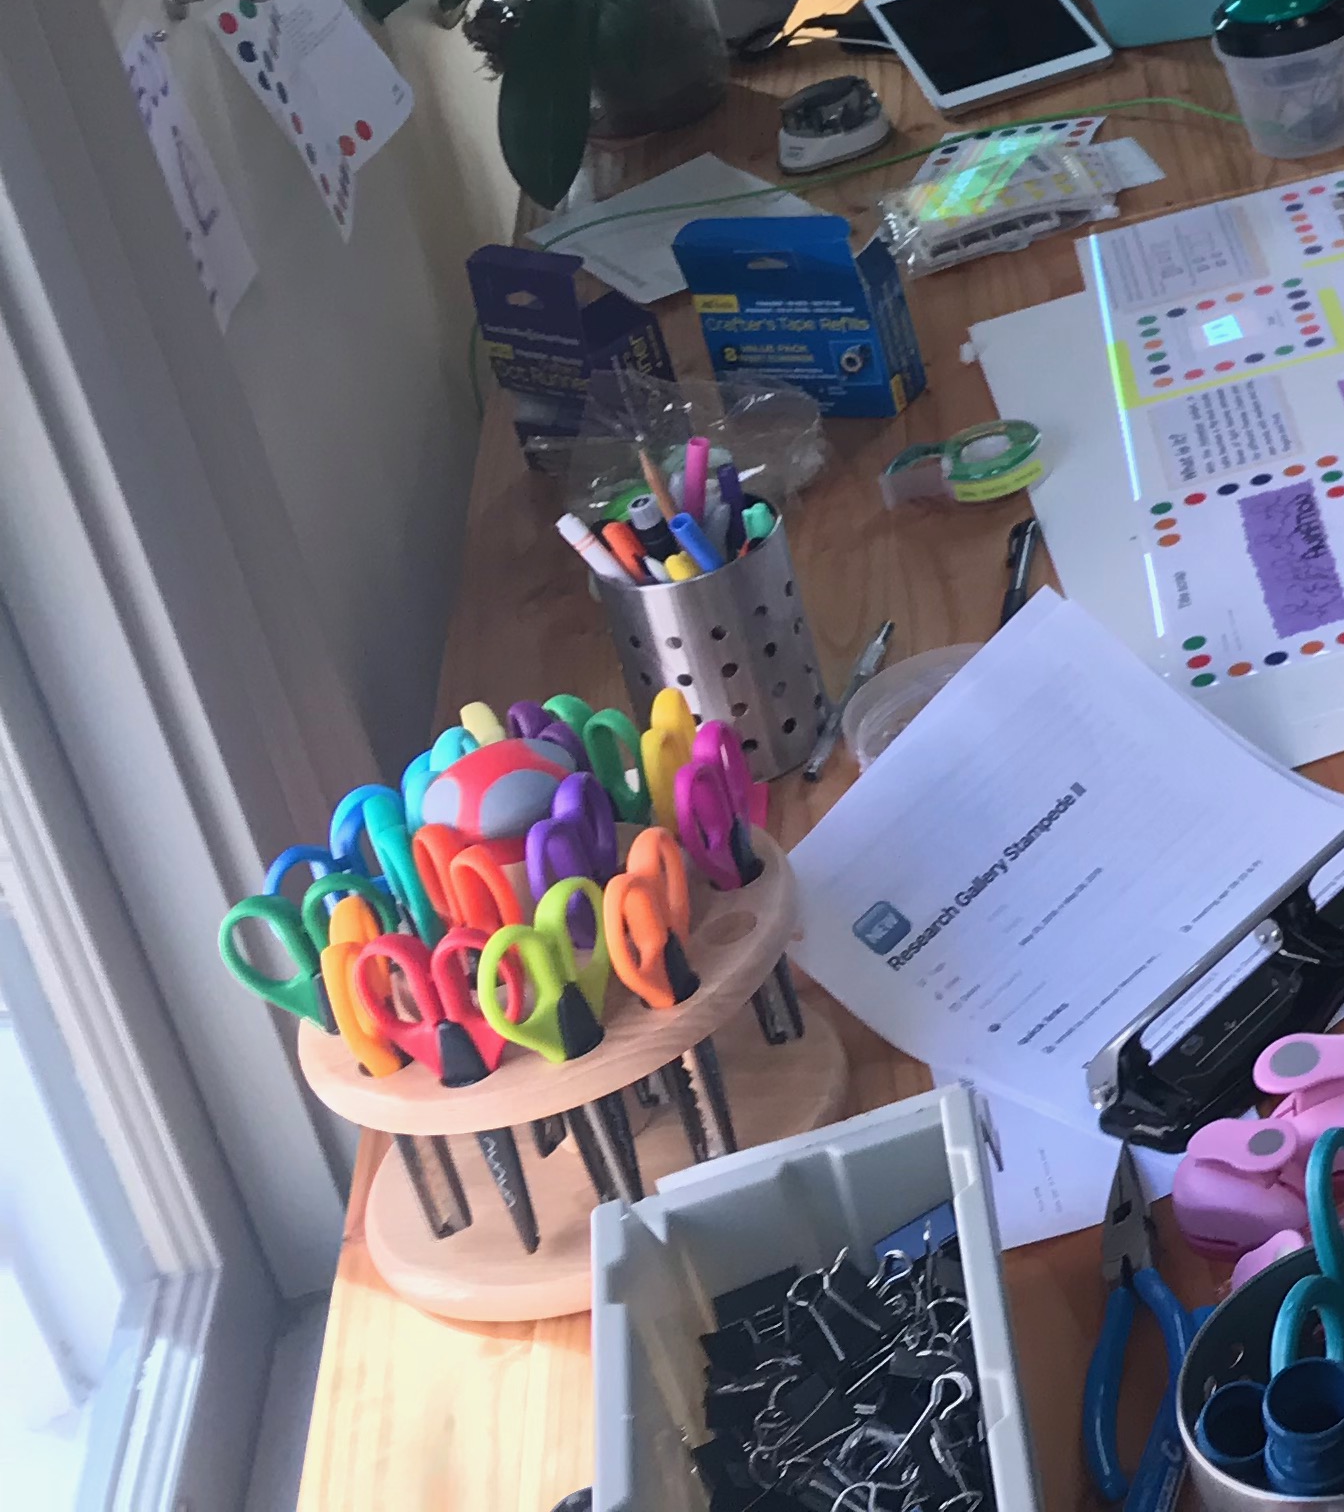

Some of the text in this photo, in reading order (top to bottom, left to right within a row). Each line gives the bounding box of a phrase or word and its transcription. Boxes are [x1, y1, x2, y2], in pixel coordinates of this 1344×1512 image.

[704, 316, 871, 334] Crafter's Tape Refills
[887, 904, 961, 972] Research
[954, 858, 1009, 908] Gallery
[1003, 794, 1077, 862] Stampede
